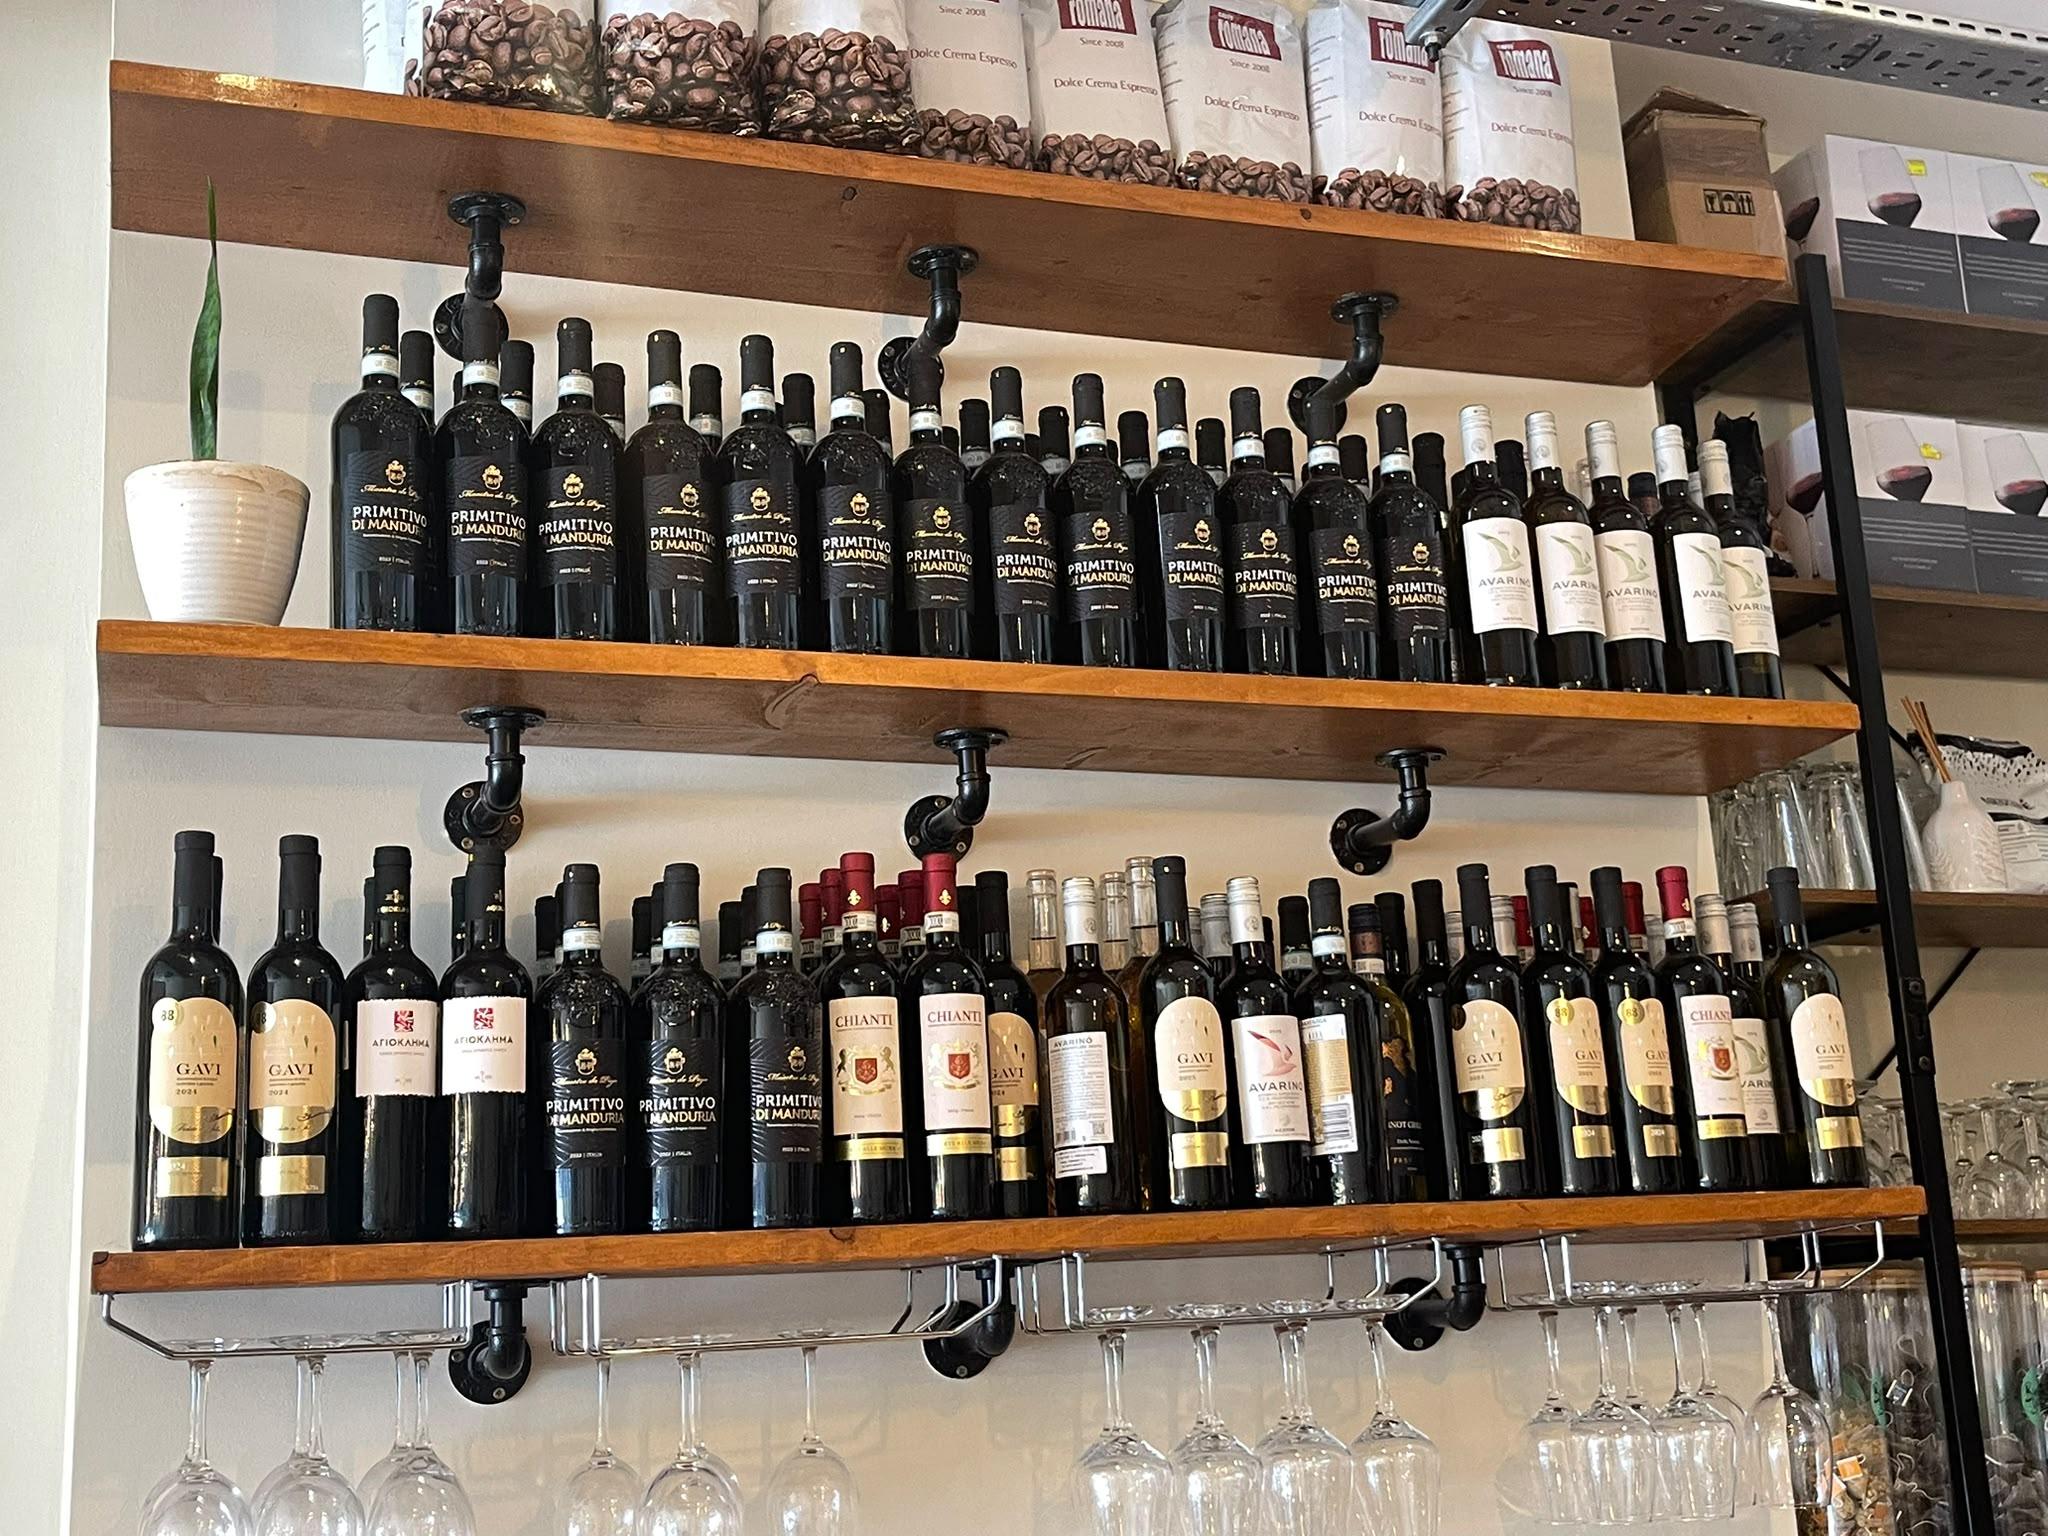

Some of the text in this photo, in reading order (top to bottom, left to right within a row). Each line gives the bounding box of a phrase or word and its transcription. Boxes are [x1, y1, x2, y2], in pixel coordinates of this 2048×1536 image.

[939, 5, 986, 17] Since 2008
[1080, 36, 1124, 48] Since 2008
[1217, 17, 1271, 56] romana
[910, 48, 1018, 70] Dolce Crema Espresso
[1499, 48, 1553, 80] romana
[1054, 78, 1158, 96] Dolce Crema Espresso
[1204, 95, 1300, 122] Dolce Crema Espresso
[1359, 111, 1387, 122] Dolce
[1388, 113, 1416, 126] Crema
[1492, 122, 1517, 134] Dolce
[1519, 124, 1547, 137] Crema
[353, 506, 428, 528] PRIMITIVO
[452, 510, 526, 530] PRIMITIVO
[352, 519, 366, 531] DI
[452, 524, 462, 536] DI
[538, 518, 613, 536] PRIMITIVO
[550, 532, 614, 546] MANDURIA
[650, 540, 662, 551] DI
[726, 531, 798, 548] PRIMITIVO
[822, 536, 892, 554] PRIMITIVO
[738, 544, 798, 558] MANDURIA
[823, 550, 834, 562] DI
[906, 548, 972, 566] PRIMITIVO
[996, 567, 1009, 578] DI
[1068, 560, 1134, 576] PRIMITIVO
[1168, 574, 1182, 584] DI
[1235, 568, 1297, 584] PRIMITIVO
[1478, 577, 1532, 588] AVARINO
[1236, 582, 1247, 594] DI
[1319, 588, 1332, 599] DI
[1605, 587, 1658, 599] AVARINO
[1388, 594, 1400, 606] DI
[835, 1014, 893, 1028] CHIANTI
[928, 1010, 982, 1024] CHIANTI
[1575, 1050, 1602, 1061] GAVI
[1816, 1043, 1846, 1056] GAVI
[1178, 1052, 1214, 1064] GAVI
[1467, 1052, 1503, 1065] GAVI
[176, 1062, 222, 1076] GAVI
[268, 1063, 314, 1077] GAVI
[546, 1097, 624, 1114] PRIMITIVO
[640, 1096, 716, 1112] PRIMITIVO
[756, 1094, 822, 1108] PRIMITIVO
[547, 1112, 624, 1128] DI MANDURIA
[650, 1111, 716, 1125] MANDURIA
[756, 1108, 769, 1120] DI
